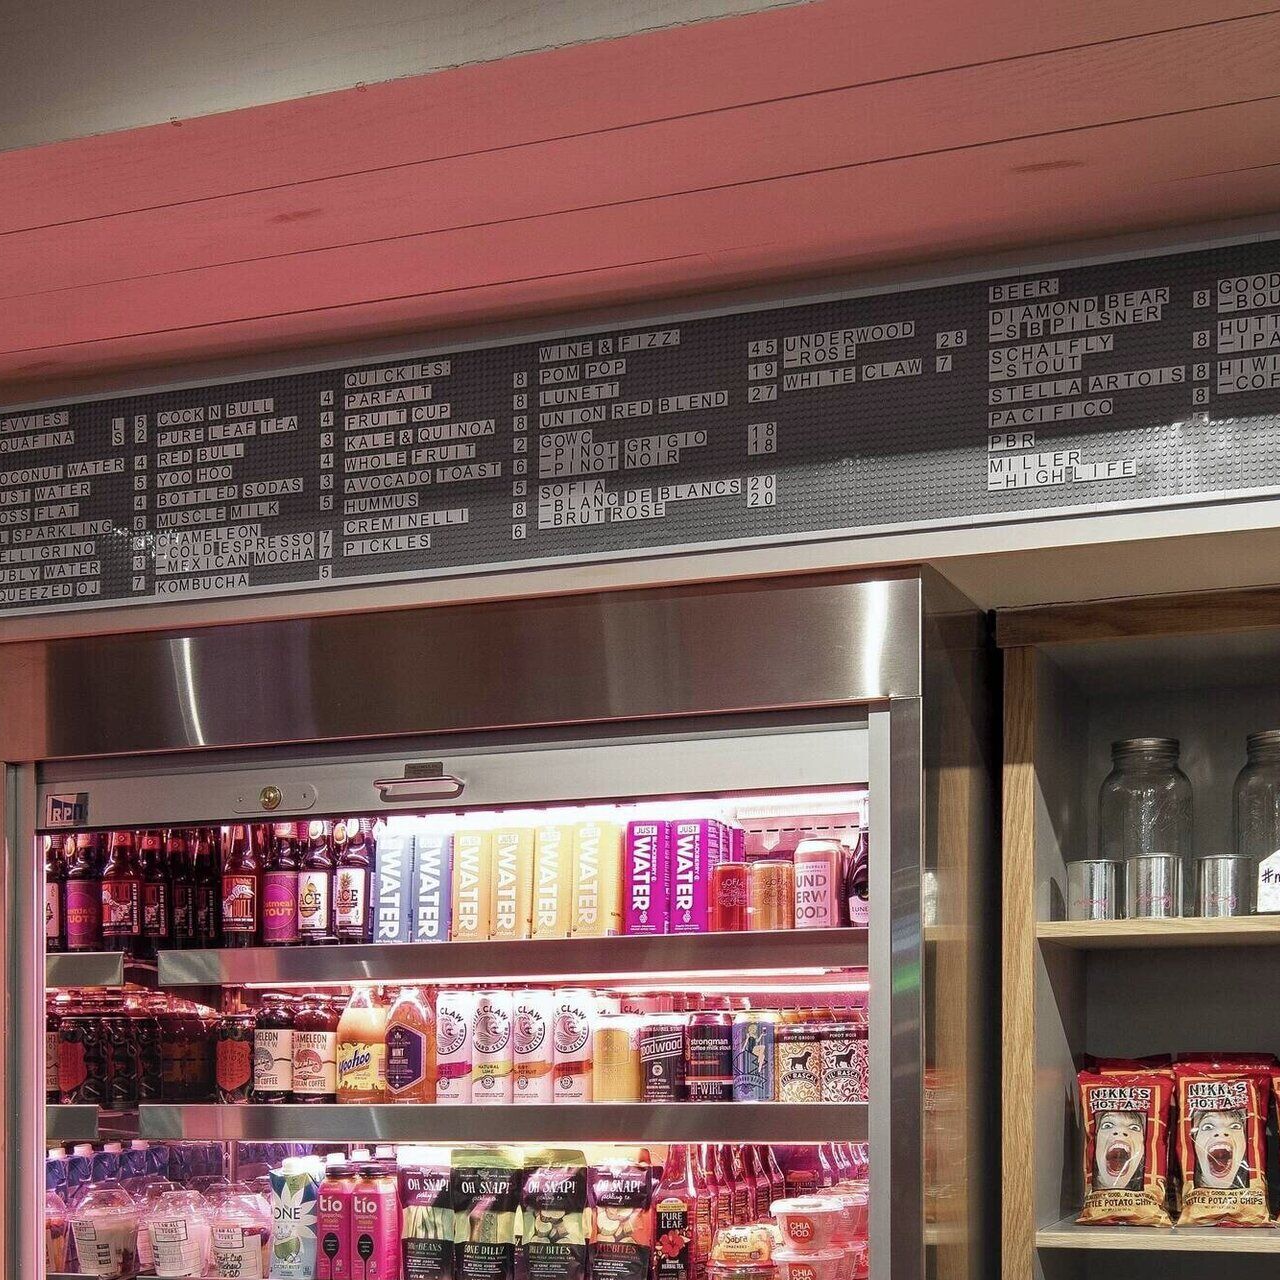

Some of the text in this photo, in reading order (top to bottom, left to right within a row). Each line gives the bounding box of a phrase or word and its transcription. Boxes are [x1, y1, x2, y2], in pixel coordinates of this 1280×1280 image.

[992, 280, 1058, 300] BEER:
[991, 288, 1167, 325] DIAMOND BEAR
[785, 322, 913, 351] UNDERWOOD
[540, 342, 591, 361] WINE
[601, 342, 611, 354] &
[991, 336, 1112, 364] SCHALFLY
[346, 362, 449, 387] QUICKIES:
[541, 360, 625, 382] POM POP
[785, 360, 921, 389] WHITE CLAW
[347, 386, 430, 406] PARFAIT
[541, 384, 618, 405] LUNETT
[991, 368, 1183, 403] STELLA ARTOIS
[158, 399, 271, 424] COCK N BULL
[346, 405, 450, 430] FRUIT CUP
[540, 392, 726, 427] UNION RED BLEND
[990, 400, 1112, 426] PACIFICO
[158, 417, 296, 445] PURE LEAF TEA
[346, 420, 493, 450] KALE & QUINOA
[541, 430, 592, 448] GOWC
[990, 433, 1034, 450] PBR
[158, 444, 242, 465] RED BULL
[346, 444, 473, 470] WHOLE FRUIT
[990, 451, 1080, 473] MILLER
[67, 459, 123, 476] WATER
[158, 466, 231, 486] YOO HOO
[345, 463, 500, 491] AVOCADO TOAST
[34, 483, 89, 499] WATER
[158, 479, 302, 506] BOTTLED SODAS
[541, 481, 605, 498] SOFIA
[36, 504, 77, 519] FLAT
[346, 494, 418, 513] HUMMUS
[157, 502, 278, 527] MUSCLE MILK
[345, 509, 466, 534] CREMINELLI
[158, 525, 259, 548] CHAMELEON
[345, 534, 429, 555] PICKLES
[44, 561, 98, 578] WATER
[77, 582, 98, 595] OJ
[157, 575, 248, 593] KOMBUCHA
[632, 836, 651, 911] WATER
[461, 1182, 476, 1194] OH
[661, 1212, 683, 1222] PURE
[789, 1222, 810, 1231] CHIA
[790, 1229, 810, 1238] POD
